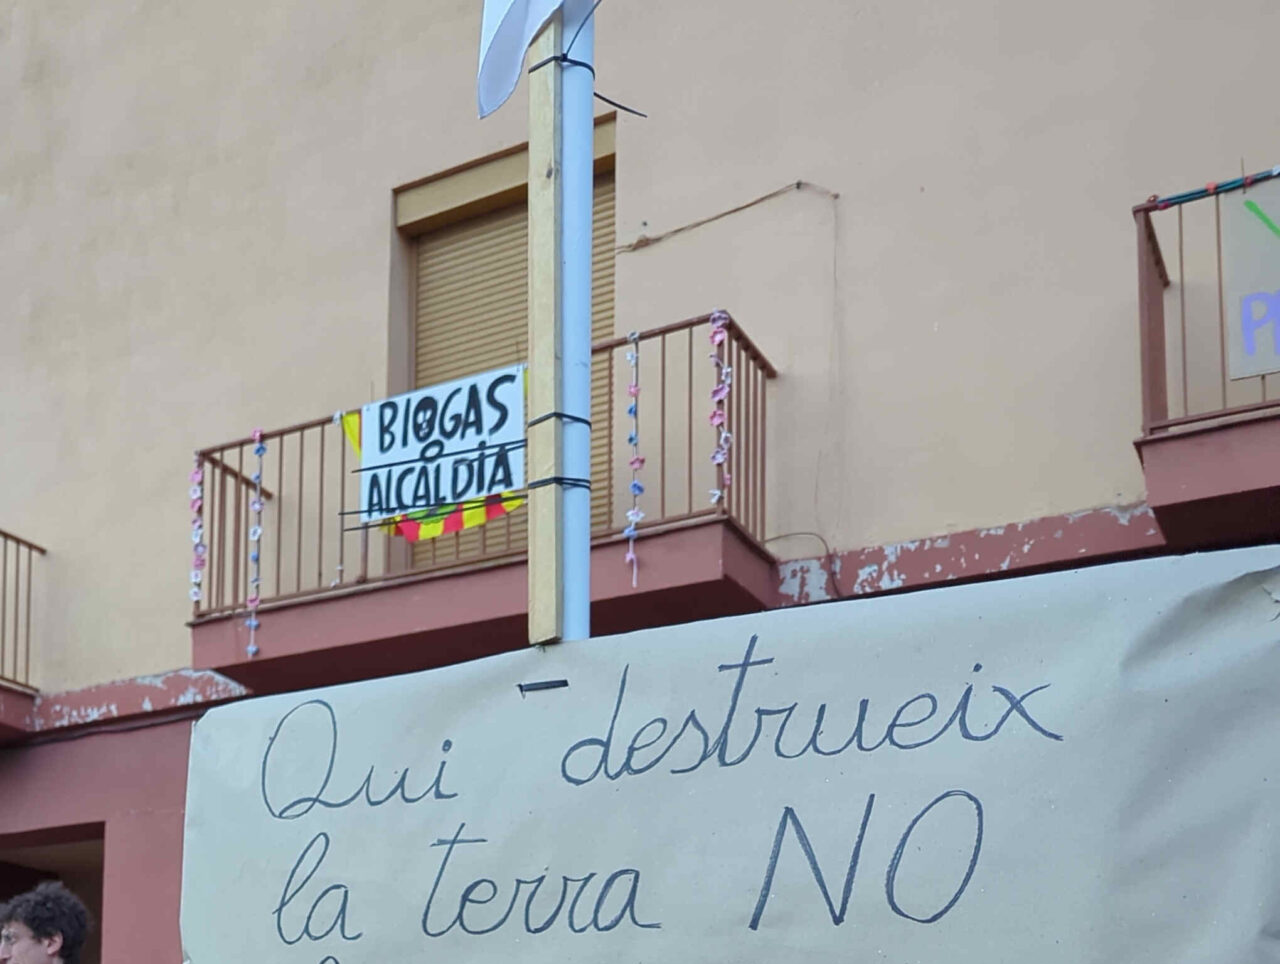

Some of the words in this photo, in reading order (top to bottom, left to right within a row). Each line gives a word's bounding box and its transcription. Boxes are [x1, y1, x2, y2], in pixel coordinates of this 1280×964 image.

[378, 373, 518, 455] BIOGAS
[260, 699, 460, 820] Qui
[560, 634, 1064, 787] destrueix
[273, 832, 363, 946] la
[421, 823, 663, 940] terra
[748, 790, 986, 932] NO
